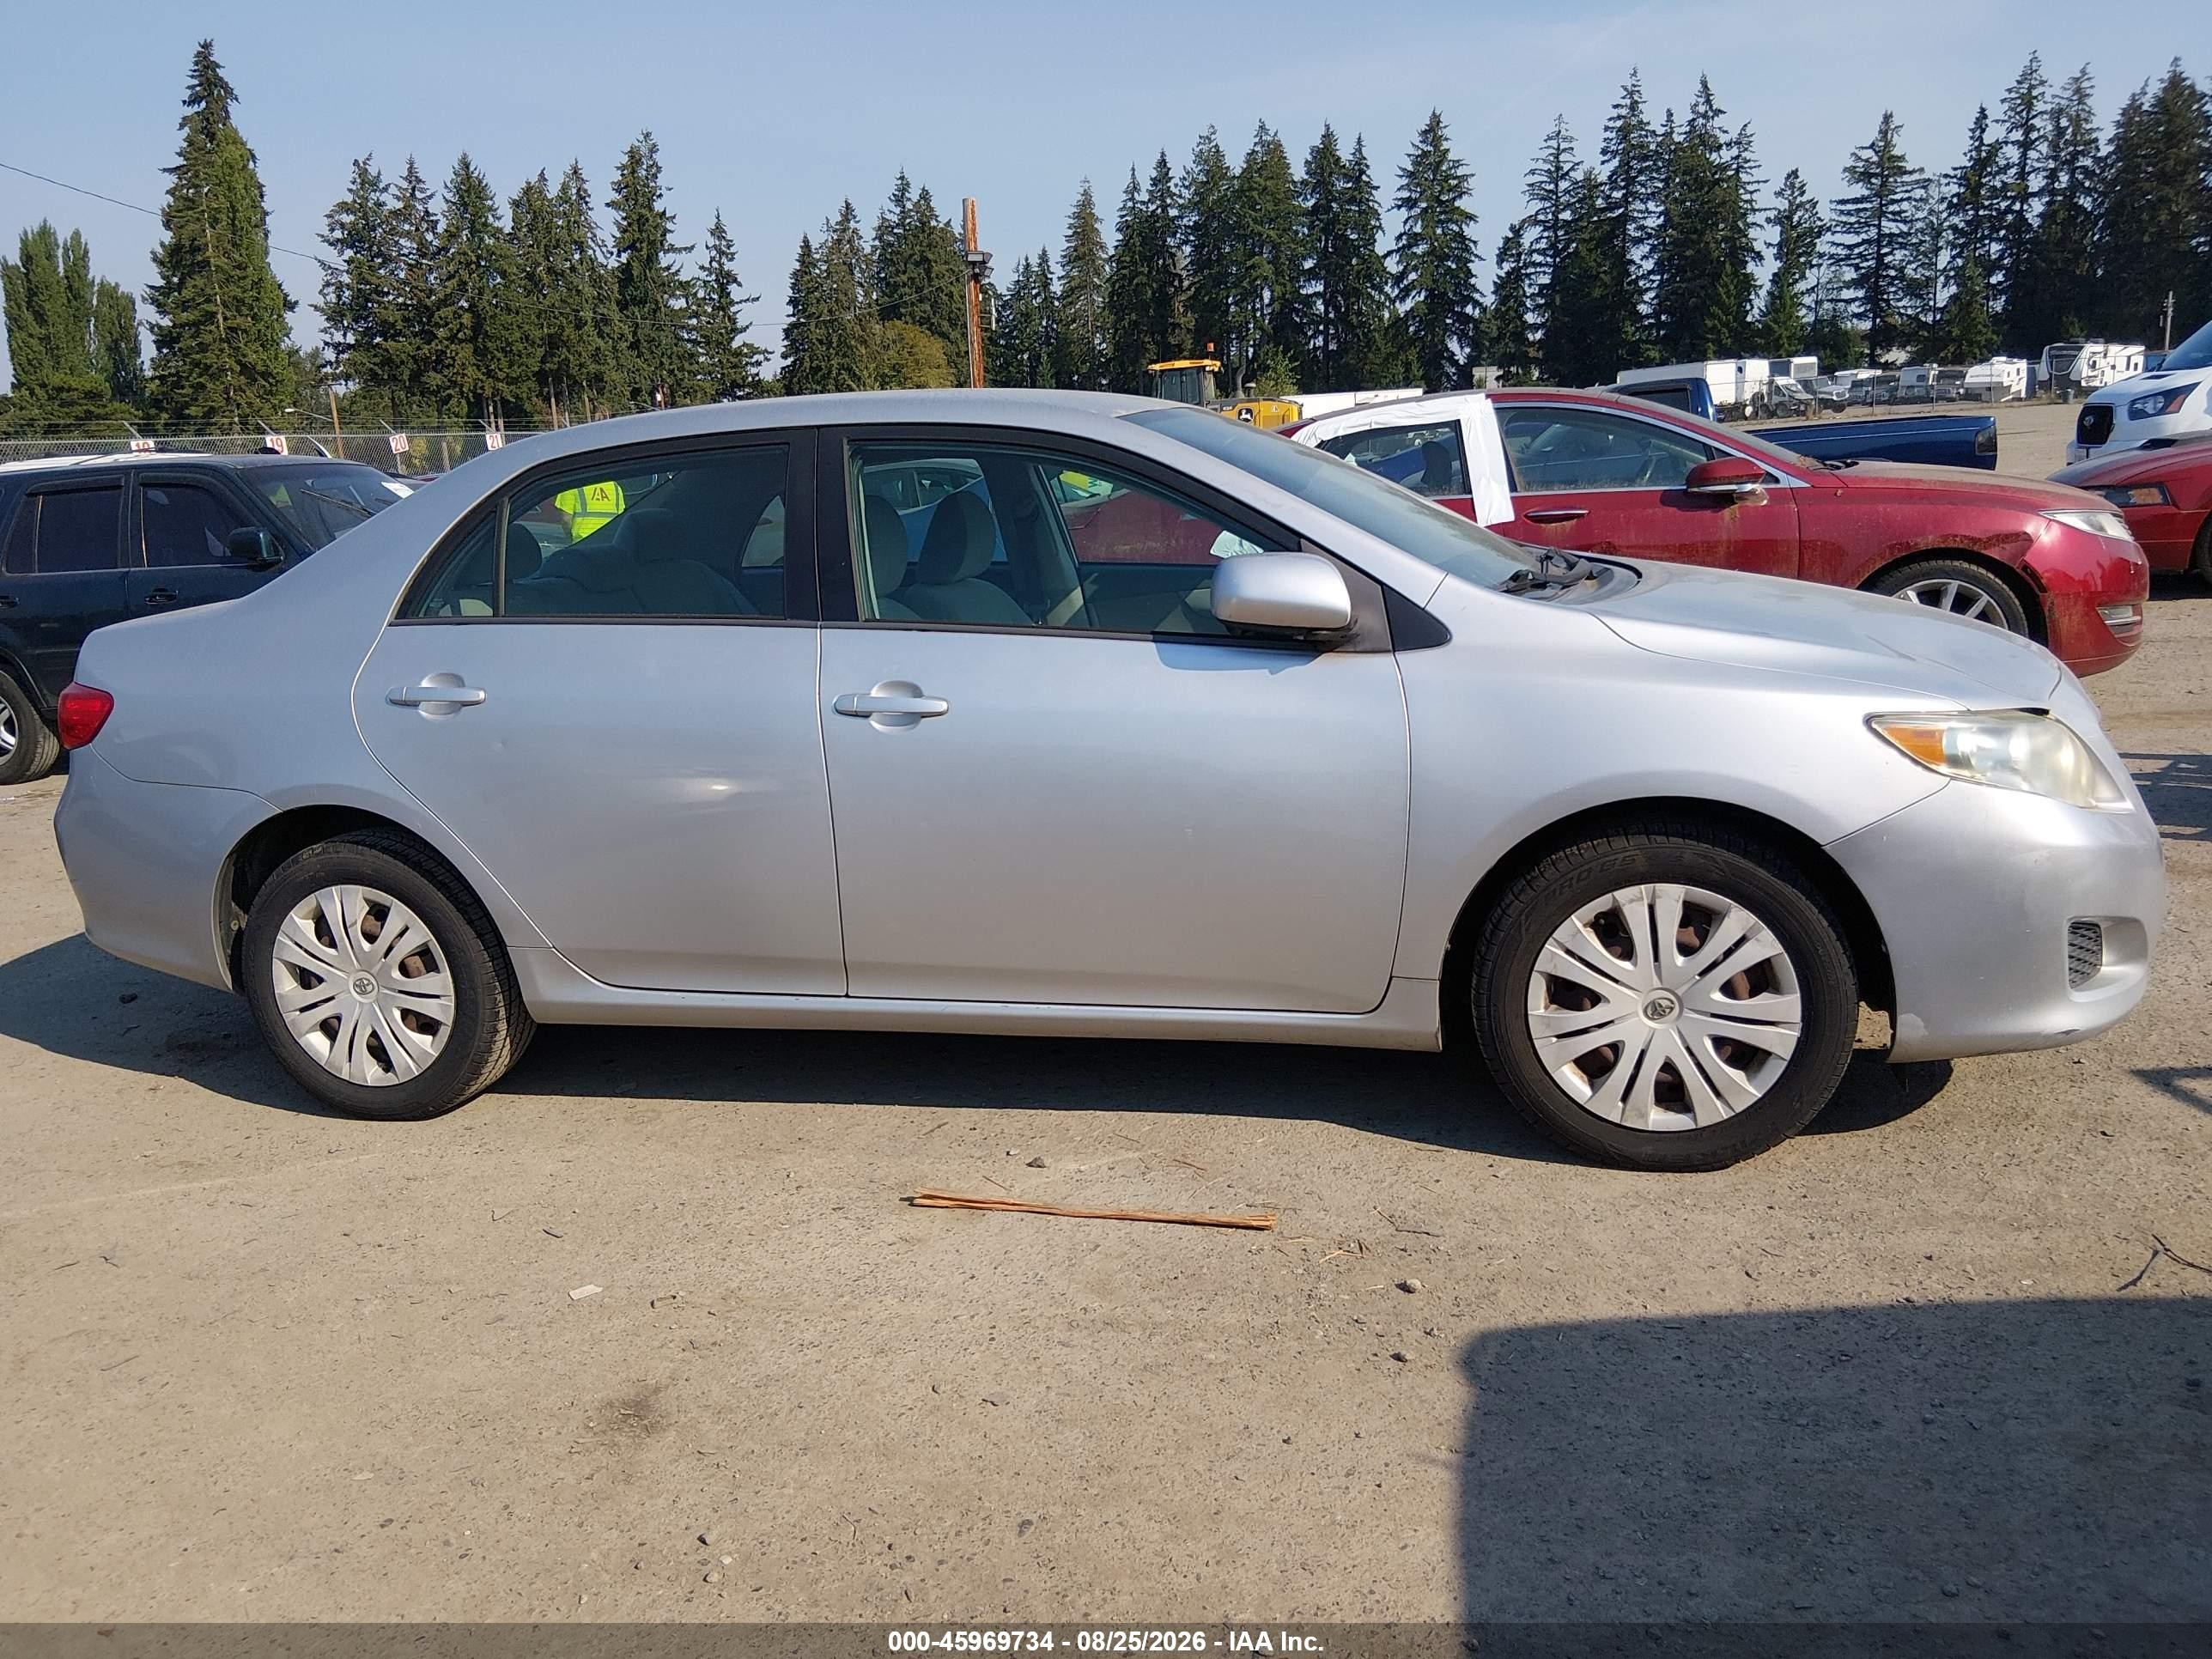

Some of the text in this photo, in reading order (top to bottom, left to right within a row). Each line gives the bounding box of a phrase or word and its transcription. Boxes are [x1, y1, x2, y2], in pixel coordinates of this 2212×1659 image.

[270, 437, 283, 454] 19
[392, 434, 407, 452] 20
[489, 434, 500, 448] 21
